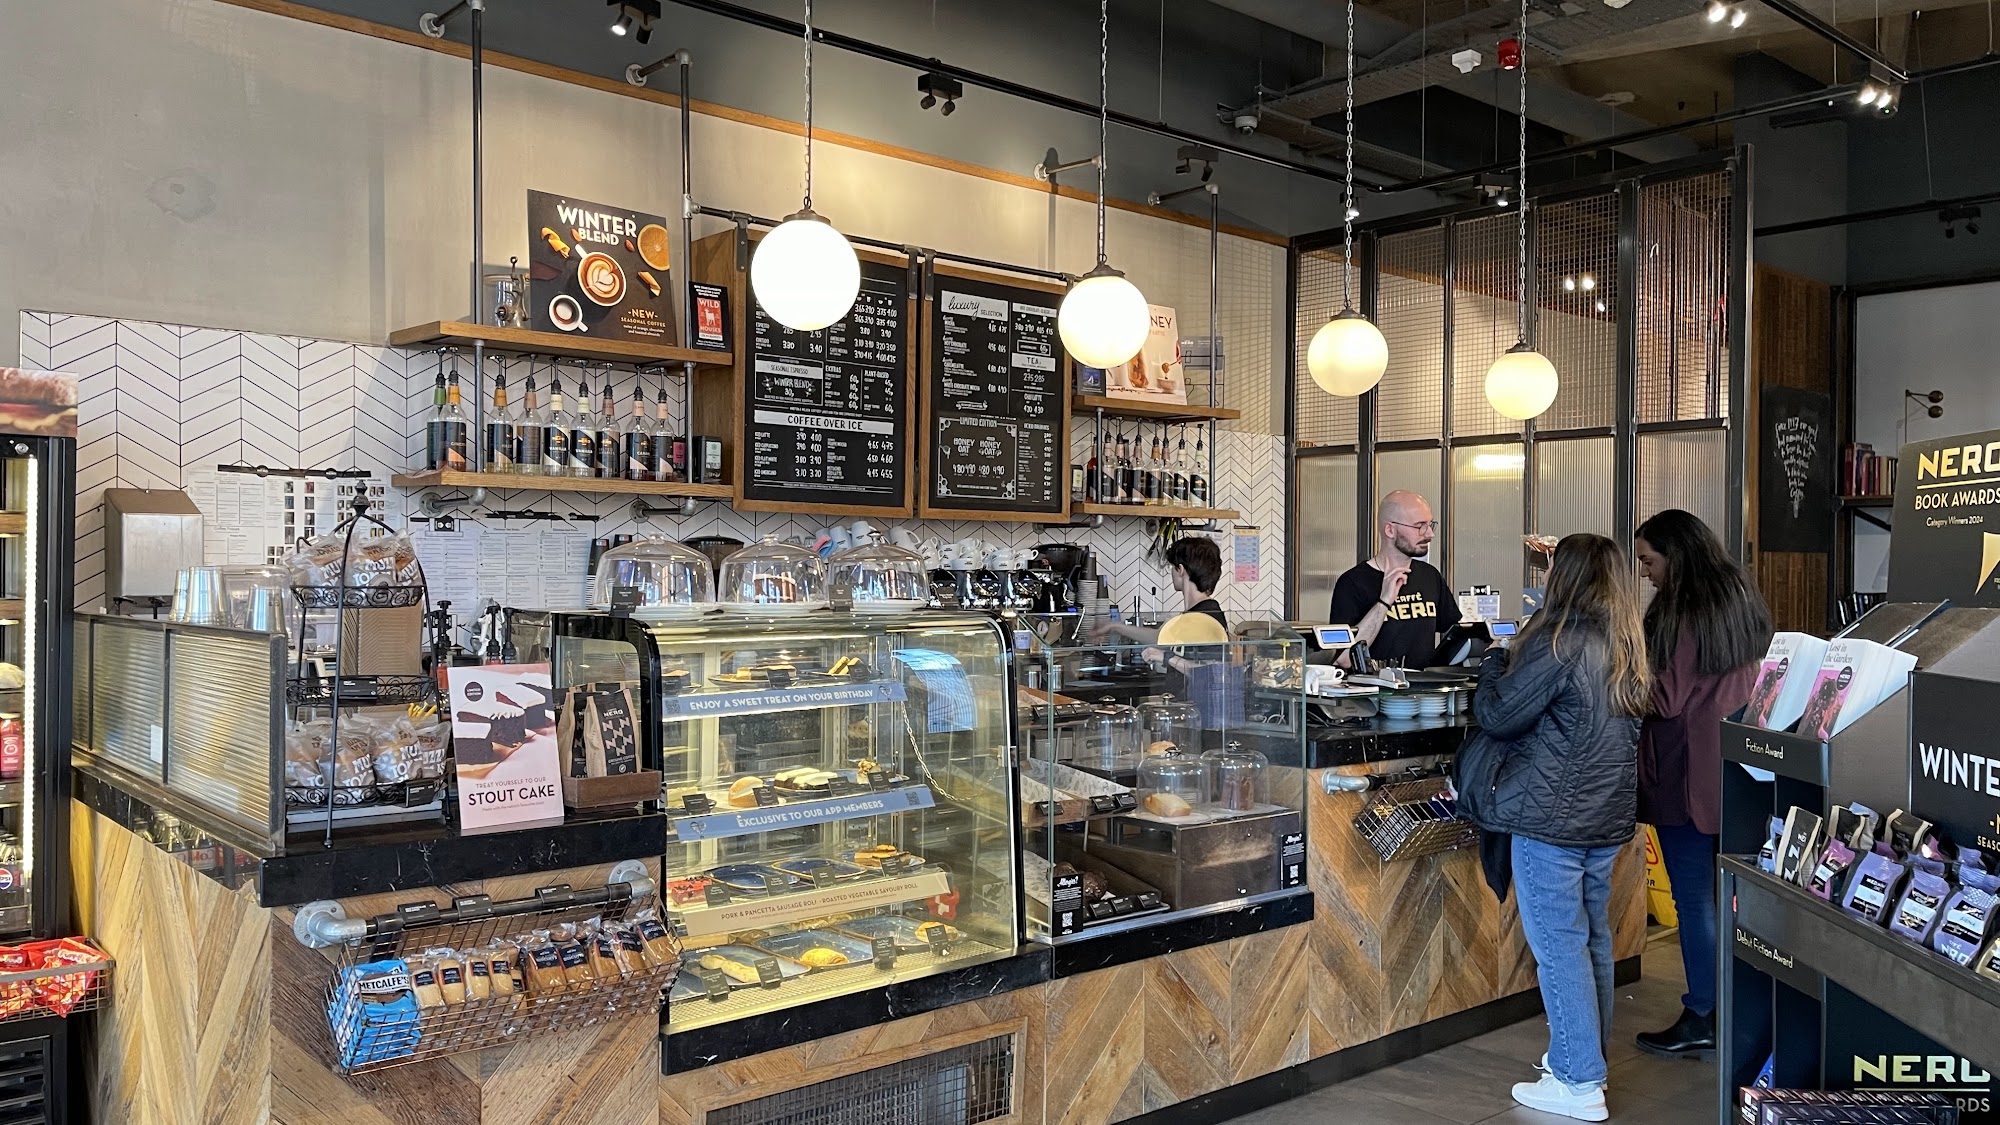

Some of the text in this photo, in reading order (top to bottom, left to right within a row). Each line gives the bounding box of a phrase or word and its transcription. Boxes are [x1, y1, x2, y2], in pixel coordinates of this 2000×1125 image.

[557, 204, 637, 238] WINTER
[578, 227, 620, 246] BLEND
[699, 299, 720, 308] WILD
[948, 296, 980, 321] luxury
[1150, 316, 1172, 329] NEY
[788, 415, 863, 430] COFFEE OVER ICE
[960, 417, 997, 427] LIMITED EDITION
[953, 438, 975, 446] HONEY
[980, 441, 1001, 449] HONEY
[985, 448, 996, 456] OAT
[1917, 441, 2000, 481] NERO
[1914, 488, 2000, 510] BOOK AWARDS
[1926, 515, 1984, 528] Category Winners 2024
[1383, 601, 1436, 621] NERO
[1833, 654, 1853, 663] Garden
[689, 701, 721, 711] ENJOY
[732, 698, 762, 707] SWEET
[764, 696, 791, 704] TREAT
[793, 694, 807, 702] ON
[808, 691, 833, 701] YOUR
[834, 689, 874, 699] BIRTHDAY
[1745, 737, 1784, 760] Fiction Award
[1919, 742, 2000, 797] WINTE
[495, 779, 524, 787] YOURSELF
[468, 784, 555, 806] STOUT CAKE
[737, 800, 884, 828] EXCLUSIVE TO OUR APP MEMBERS
[721, 912, 738, 920] PORK
[745, 907, 776, 917] PANCETTA
[776, 902, 803, 912] SAUSAGE
[821, 895, 848, 904] ROASTED
[849, 889, 879, 900] VEGETABLE
[904, 882, 919, 890] ROLL
[1736, 928, 1793, 969] Debut Fiction Award
[358, 976, 409, 990] METCALFE'S
[1854, 1054, 1991, 1083] NERO
[1956, 1097, 1991, 1113] RDS
